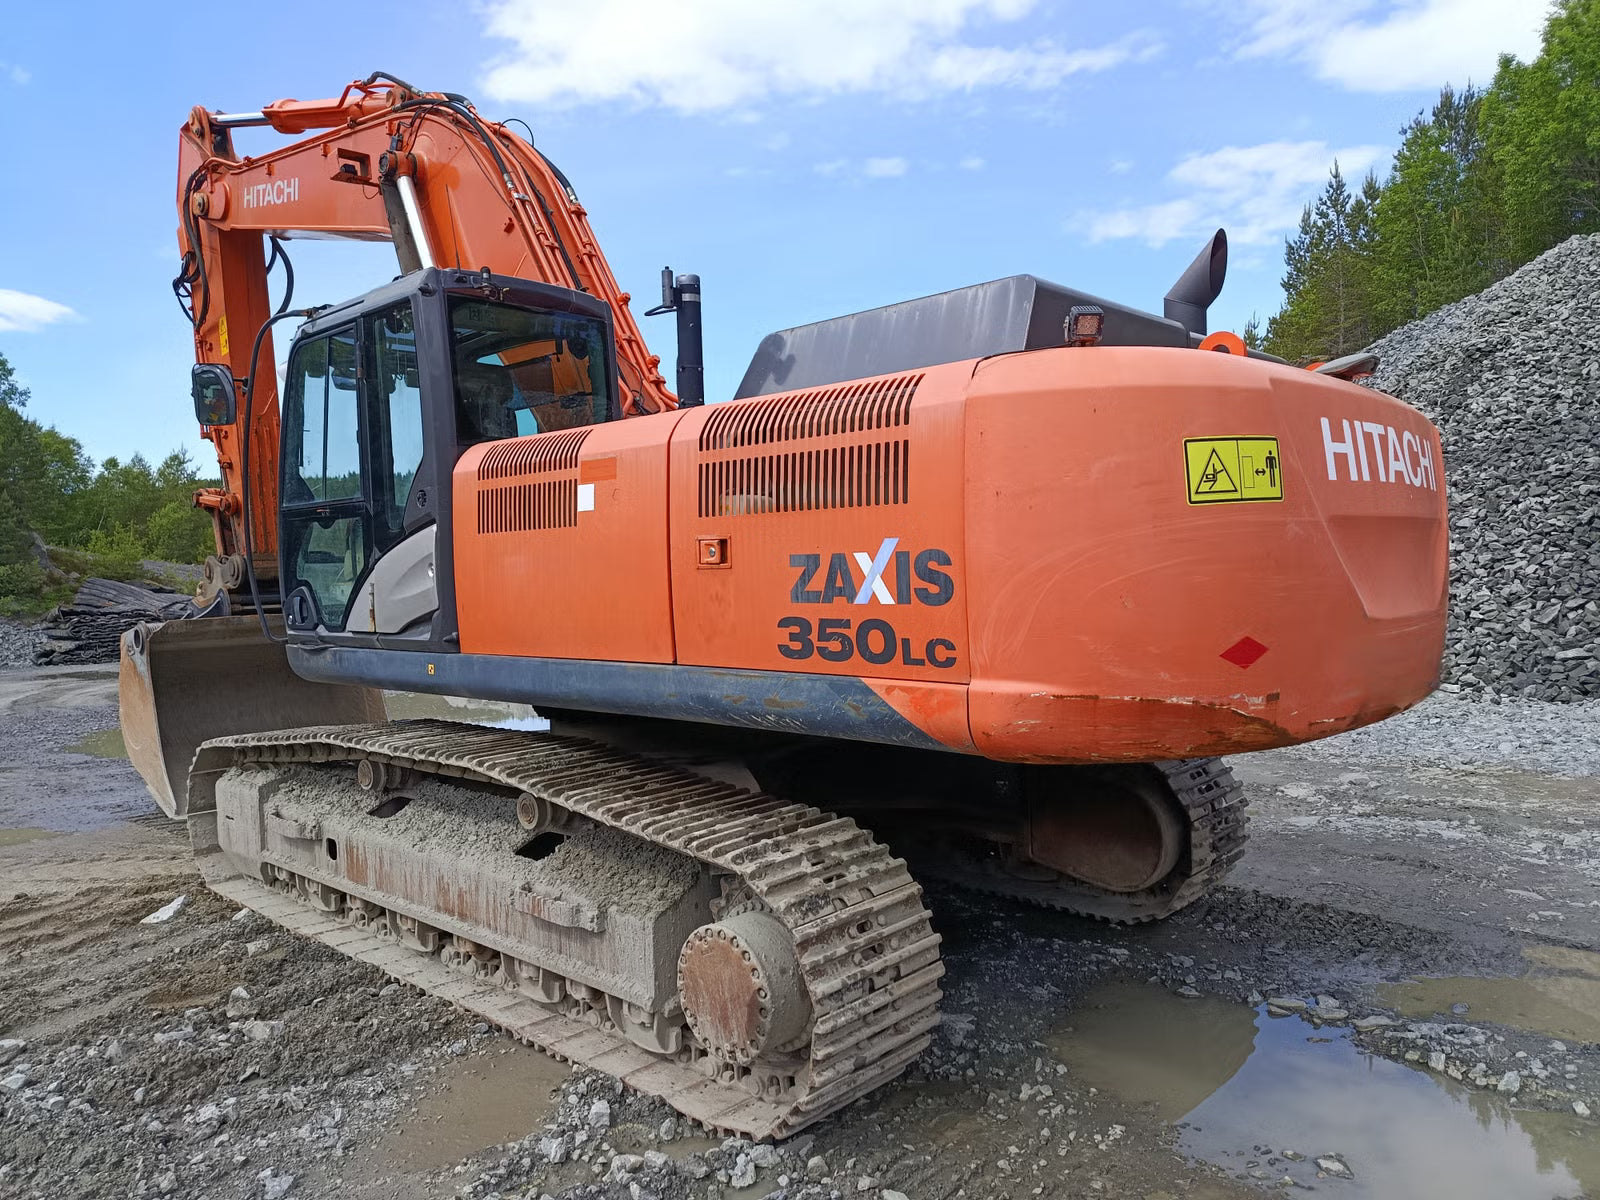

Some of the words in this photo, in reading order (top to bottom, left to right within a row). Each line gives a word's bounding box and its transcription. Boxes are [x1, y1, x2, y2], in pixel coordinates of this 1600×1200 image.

[243, 177, 299, 208] HITACHI
[1320, 416, 1437, 492] HITACHI
[789, 537, 955, 606] ZAXIS
